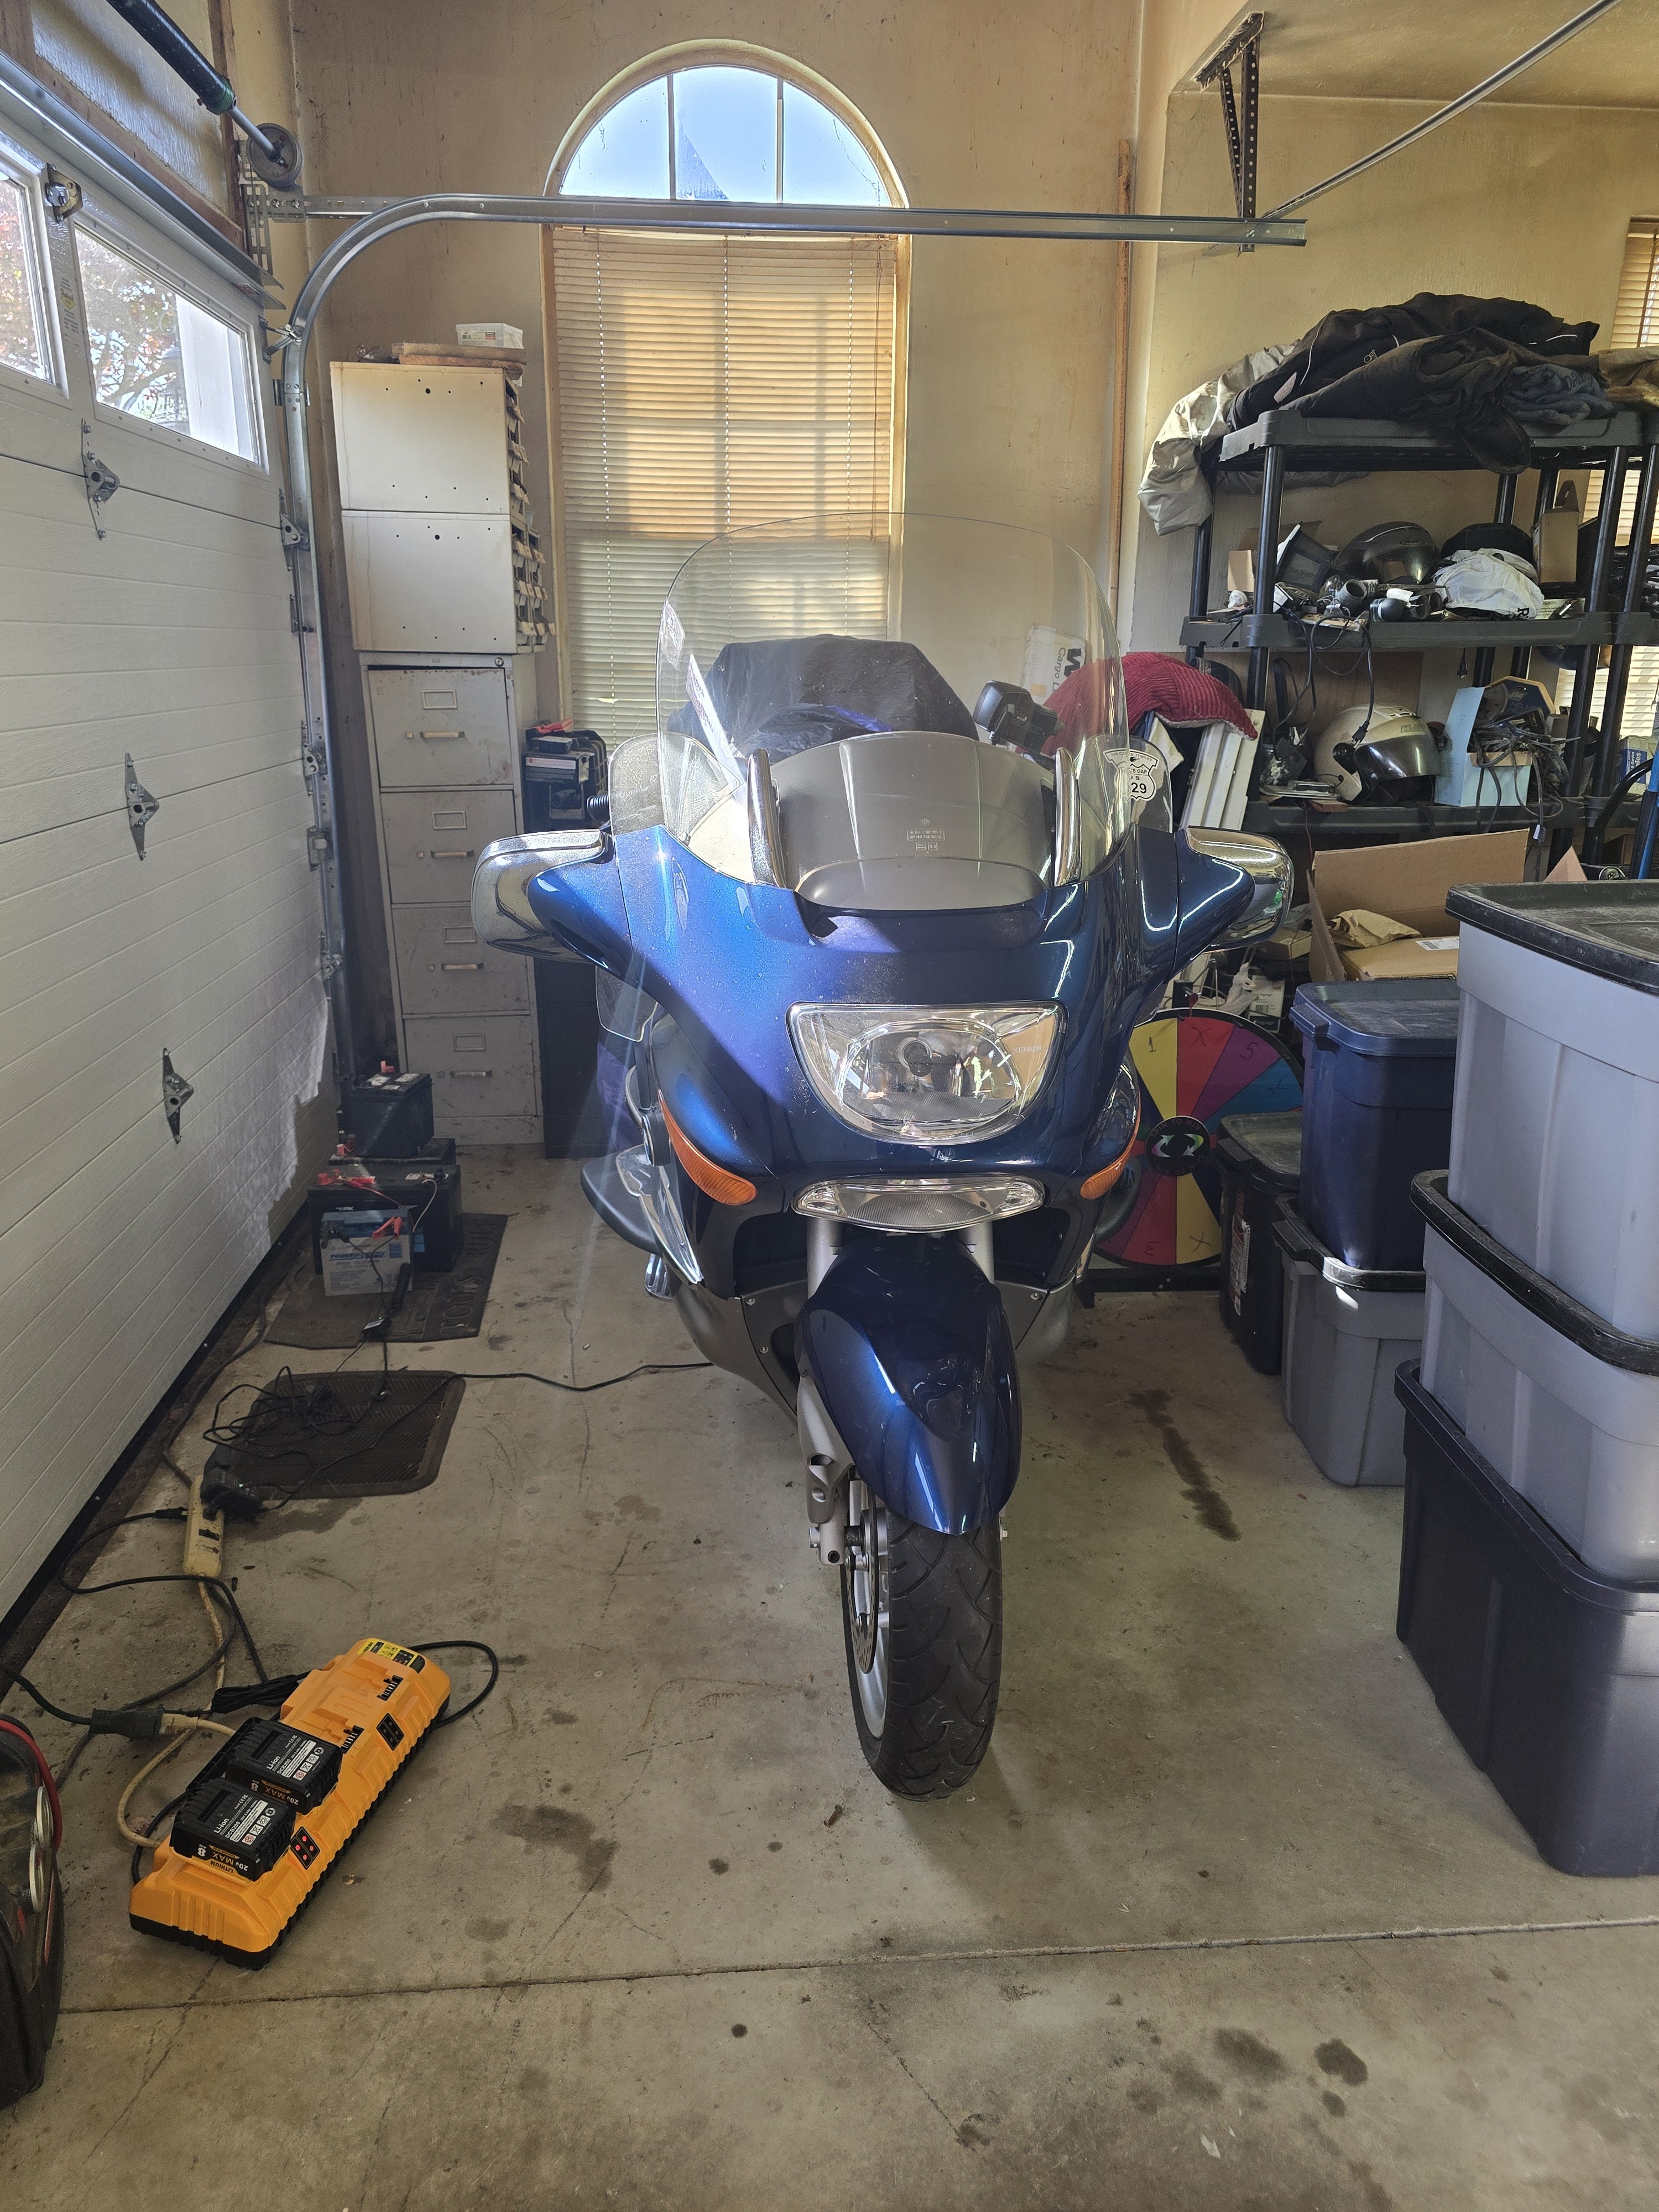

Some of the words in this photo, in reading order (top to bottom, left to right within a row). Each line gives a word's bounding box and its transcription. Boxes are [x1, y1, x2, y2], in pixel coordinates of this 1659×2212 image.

[1055, 647, 1066, 679] Cargo
[1129, 782, 1147, 794] 29
[1013, 1045, 1042, 1053] XENON
[1149, 1036, 1156, 1053] 1
[1240, 1042, 1258, 1061] 5
[1151, 1123, 1168, 1138] SPIN
[1185, 1119, 1201, 1130] WIN
[276, 1759, 291, 1774] DCB200
[251, 1782, 259, 1792] 8
[265, 1787, 285, 1799] MAX
[225, 1820, 241, 1839] DCB200
[197, 1848, 206, 1857] 8
[212, 1851, 234, 1865] MAX
[210, 1860, 233, 1874] LITHIUM
